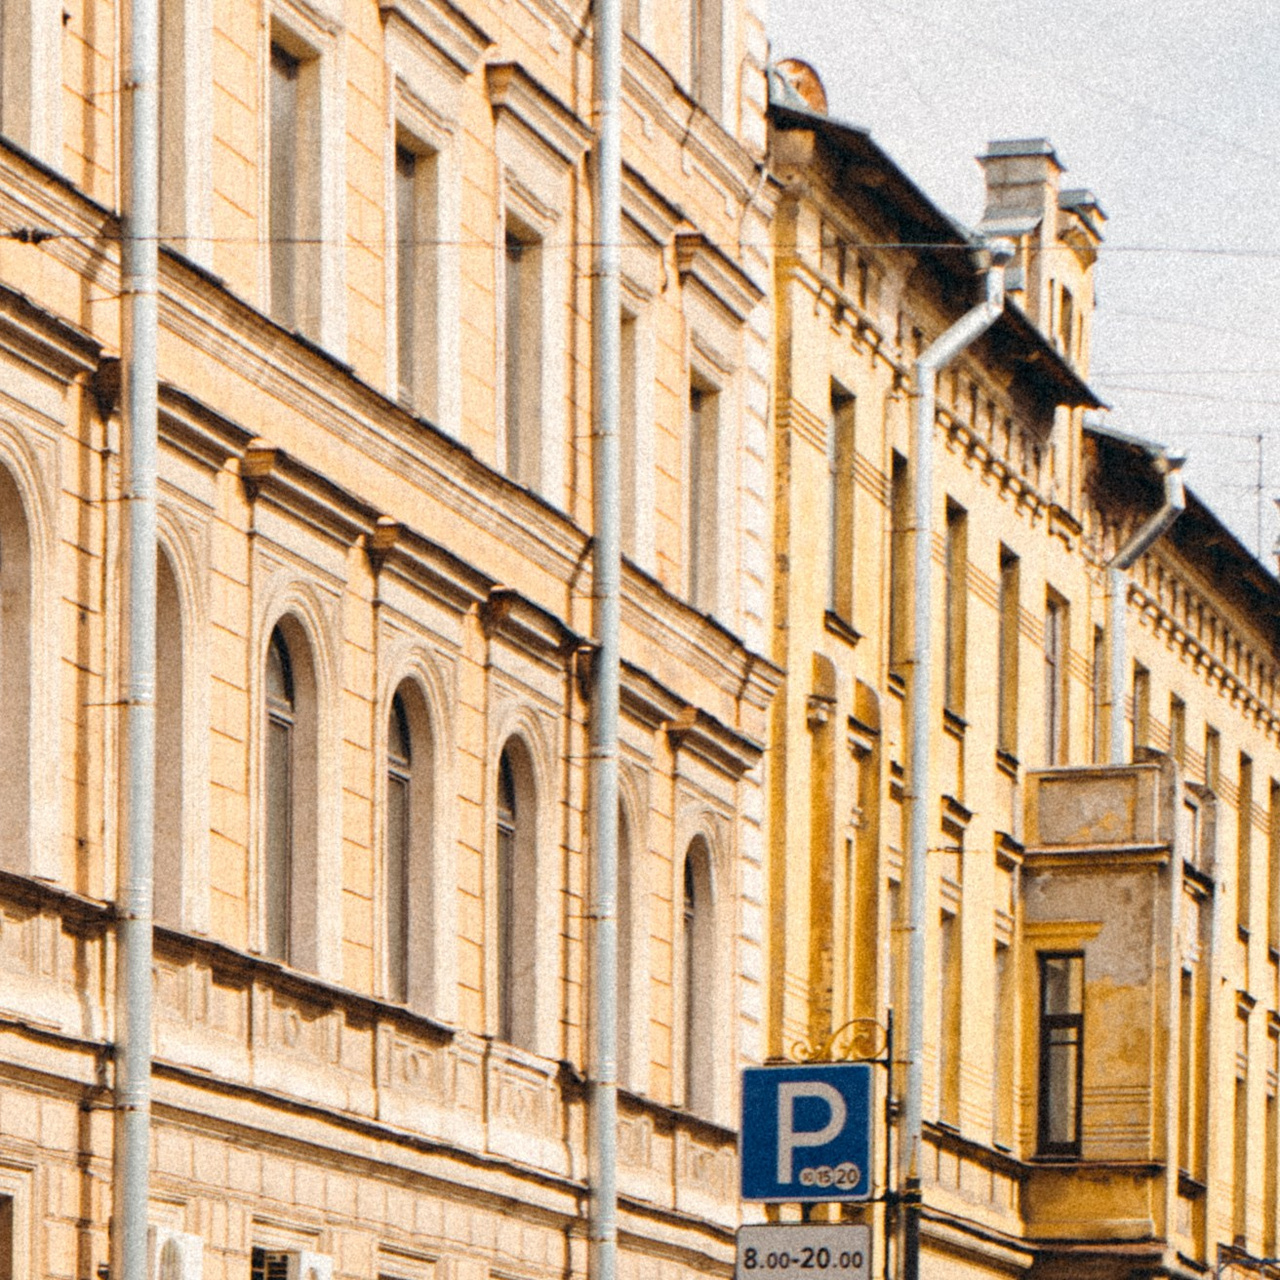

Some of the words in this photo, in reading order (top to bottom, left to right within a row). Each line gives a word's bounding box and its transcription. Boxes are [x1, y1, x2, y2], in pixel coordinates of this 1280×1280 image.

[777, 1081, 847, 1184] P
[817, 1170, 831, 1184] 15
[836, 1169, 858, 1184] 20
[743, 1247, 863, 1269] 8.00-20.00
